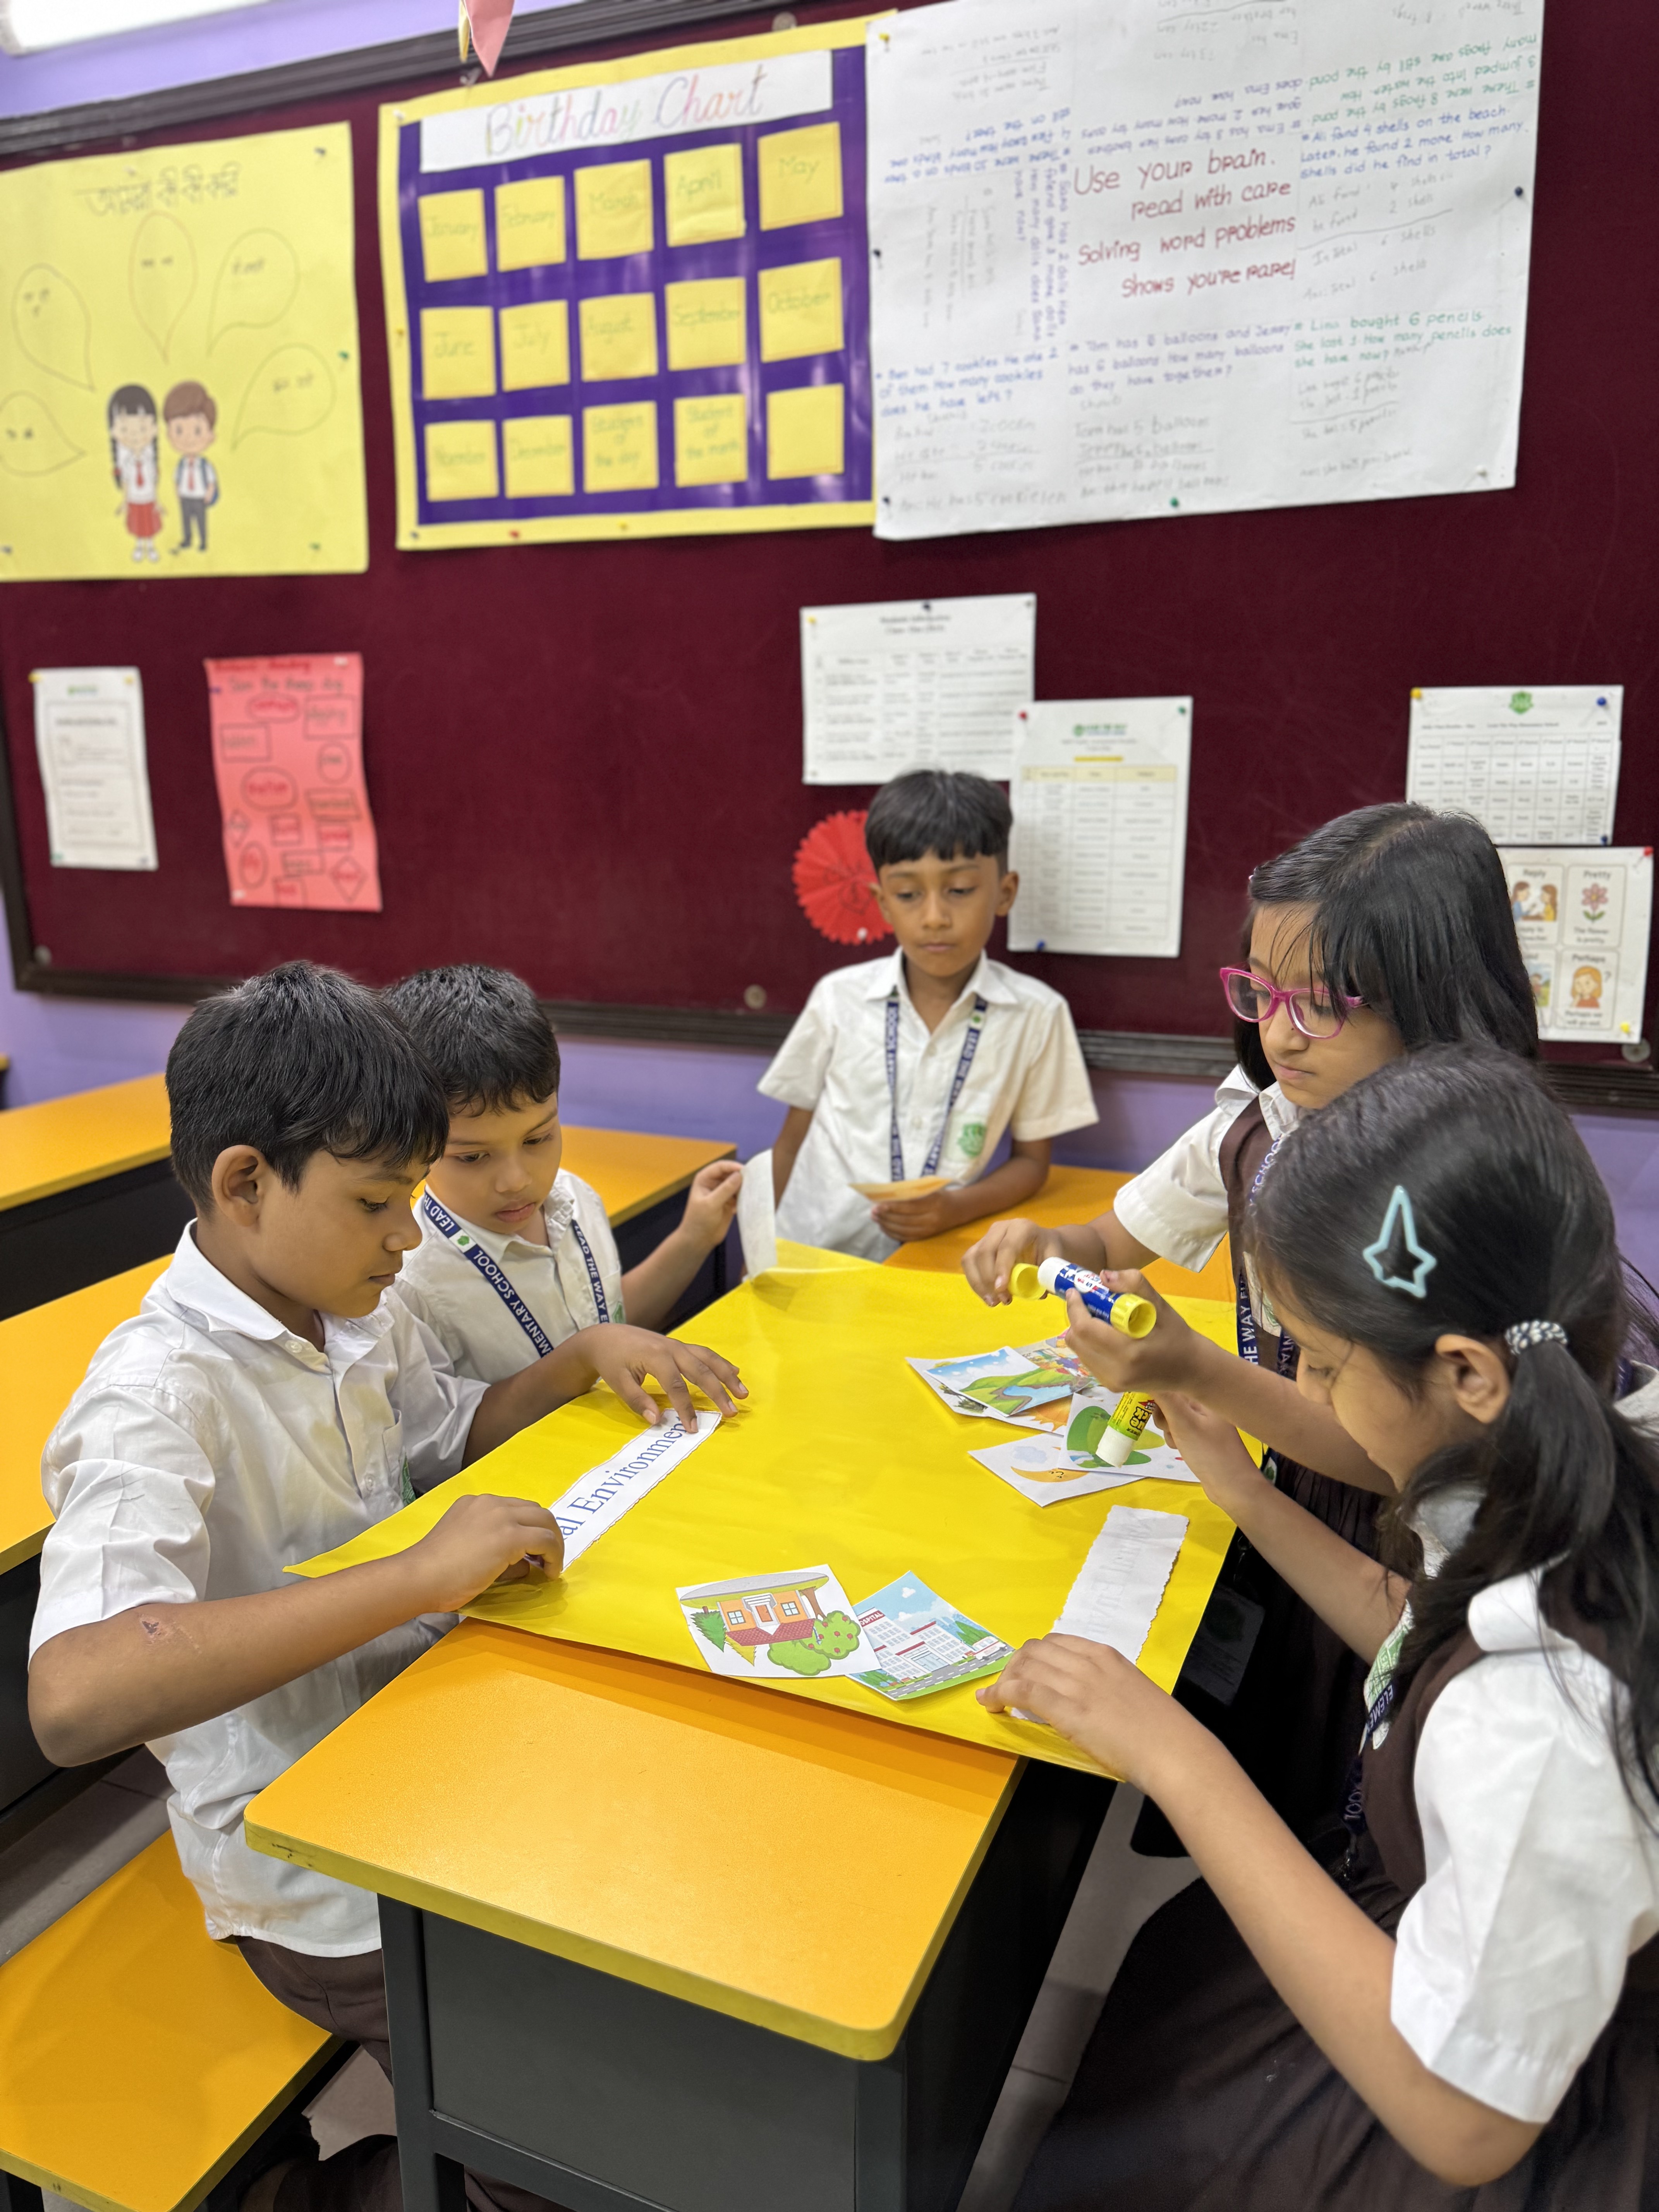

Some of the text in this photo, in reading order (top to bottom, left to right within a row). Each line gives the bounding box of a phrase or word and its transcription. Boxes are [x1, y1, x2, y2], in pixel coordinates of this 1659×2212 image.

[1458, 40, 1492, 57] frogs
[1346, 65, 1369, 80] the
[1376, 61, 1391, 74] by
[1443, 69, 1467, 82] into
[1474, 55, 1523, 77] jumped
[1416, 74, 1435, 86] the
[1482, 81, 1518, 95] There
[486, 64, 767, 156] Birthday Chart
[1371, 101, 1386, 113] by
[1393, 94, 1425, 109] frogs
[1346, 108, 1366, 121] the
[1376, 118, 1410, 134] shells
[1416, 118, 1433, 128] on
[1438, 113, 1462, 125] the
[1344, 146, 1359, 157] he
[1364, 139, 1399, 154] found
[1404, 137, 1413, 148] 2
[1462, 128, 1484, 140] How
[1073, 148, 1275, 195] Use your brain.
[1300, 163, 1336, 179] shells
[1344, 160, 1365, 174] did
[1373, 158, 1389, 170] he
[1396, 153, 1422, 167] find
[1427, 153, 1438, 163] in
[677, 170, 722, 202] April
[778, 155, 819, 183] May
[1131, 182, 1291, 222] read with care
[1078, 214, 1296, 265] Solving word problems
[1187, 267, 1241, 296] you're
[1246, 259, 1296, 280] rare!
[433, 331, 474, 358] June
[512, 323, 551, 354] July
[768, 291, 830, 314] October
[1350, 314, 1400, 329] bought
[1408, 311, 1420, 326] 6
[1394, 332, 1424, 344] many
[1432, 327, 1476, 342] pencils
[1482, 323, 1511, 338] does
[1324, 352, 1349, 364] have
[1583, 871, 1611, 881] Pretty
[1252, 1139, 1281, 1193] SCHOO
[430, 1206, 455, 1231] LEAD
[473, 1250, 515, 1299] SCHOOL
[575, 1225, 589, 1254] LEAD
[587, 1257, 598, 1278] THE
[593, 1281, 606, 1309] WAY
[510, 1300, 552, 1355] MENTARY
[1240, 1305, 1255, 1342] WAY
[1243, 1346, 1259, 1364] HE
[1130, 1415, 1148, 1432] ue
[555, 1415, 689, 1540] al Environmen
[859, 1612, 884, 1625] OSPITAL
[1343, 1791, 1363, 1820] OOL
